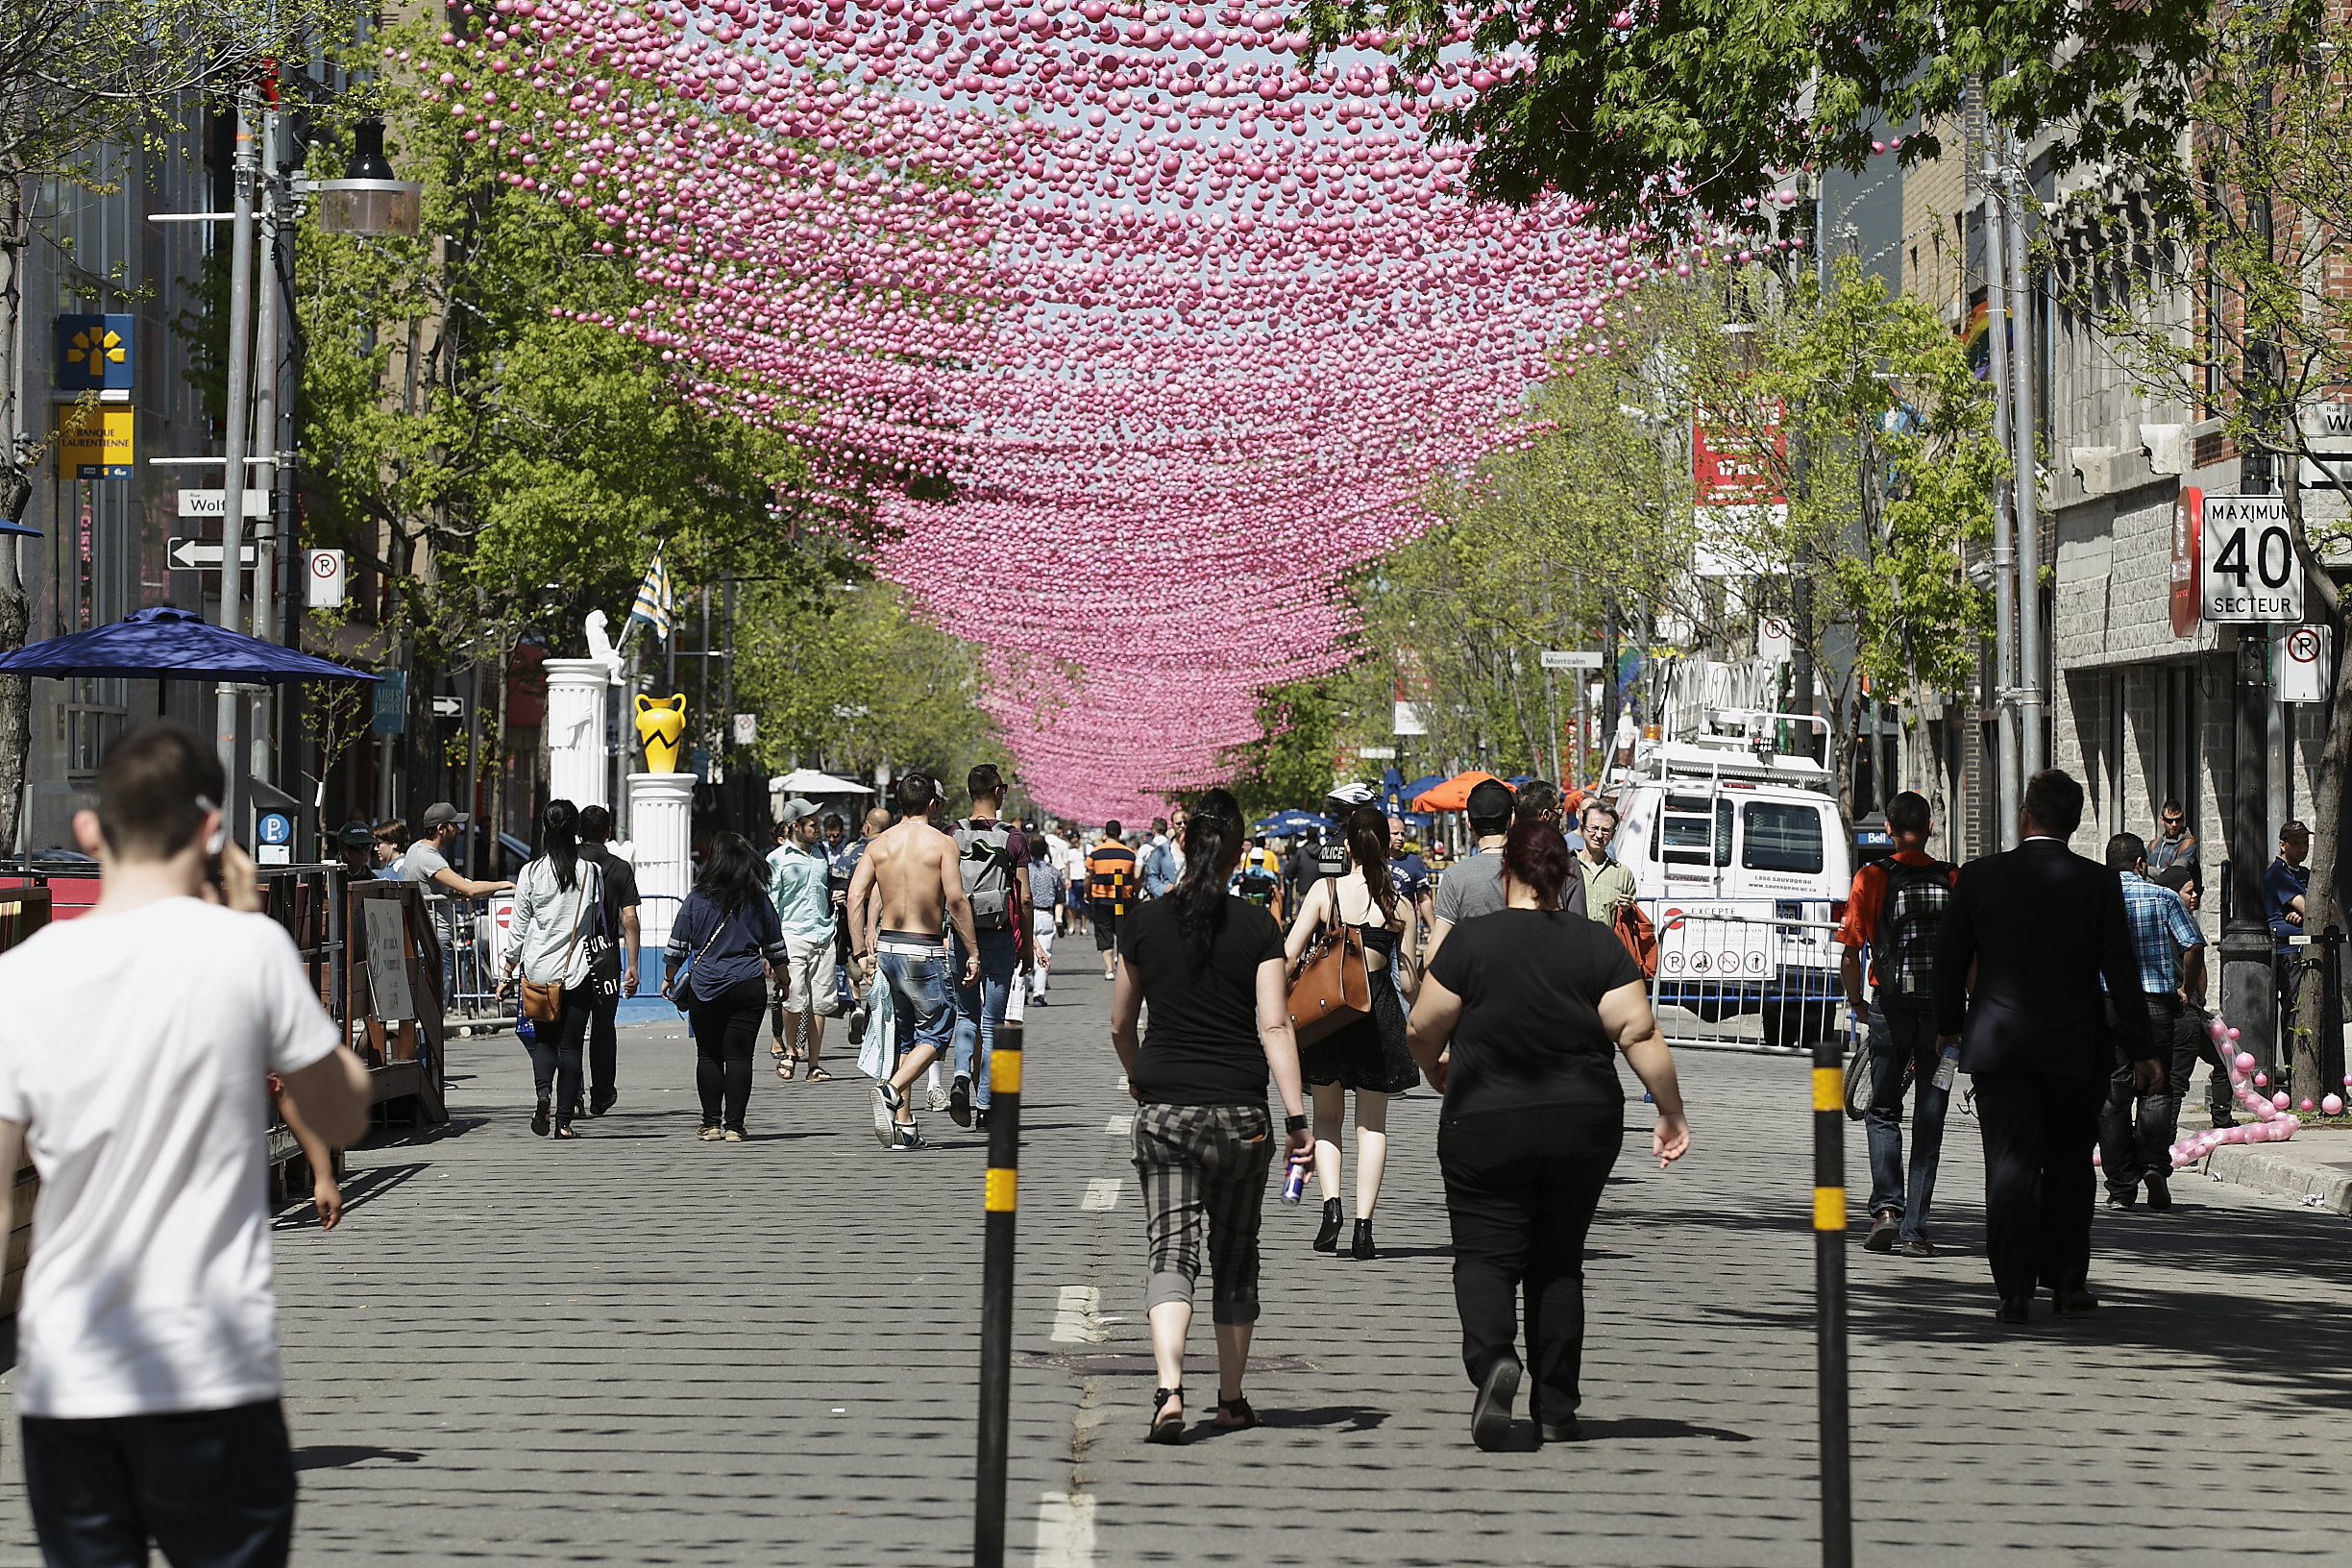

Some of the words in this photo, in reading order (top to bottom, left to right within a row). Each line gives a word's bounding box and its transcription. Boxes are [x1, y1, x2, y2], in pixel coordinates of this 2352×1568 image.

[2327, 415, 2352, 431] W
[77, 429, 115, 437] BANQUE
[62, 439, 130, 448] LAURENTIENNE
[2213, 527, 2292, 589] 40
[2214, 597, 2291, 613] SECTEUR
[1868, 832, 1886, 844] Bell
[1749, 883, 1817, 893] www.sauvageau.qc.ca
